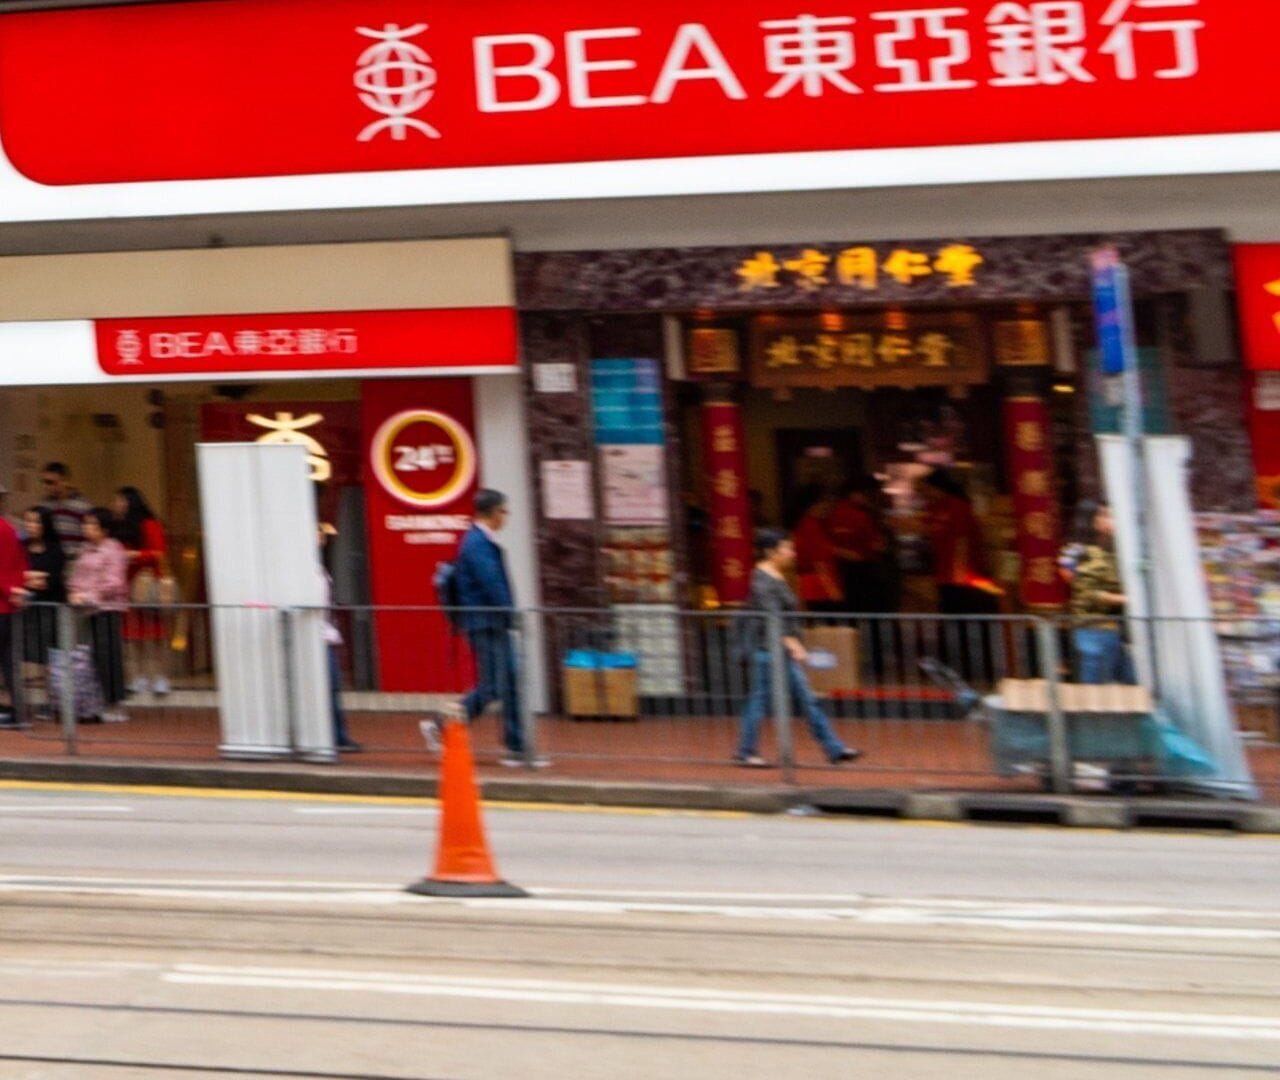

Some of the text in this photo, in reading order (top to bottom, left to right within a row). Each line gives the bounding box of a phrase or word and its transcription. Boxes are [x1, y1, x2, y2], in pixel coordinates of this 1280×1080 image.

[474, 22, 747, 114] BEA
[735, 242, 985, 293] 北京同仁堂
[148, 327, 359, 358] BEA 東亞銀行
